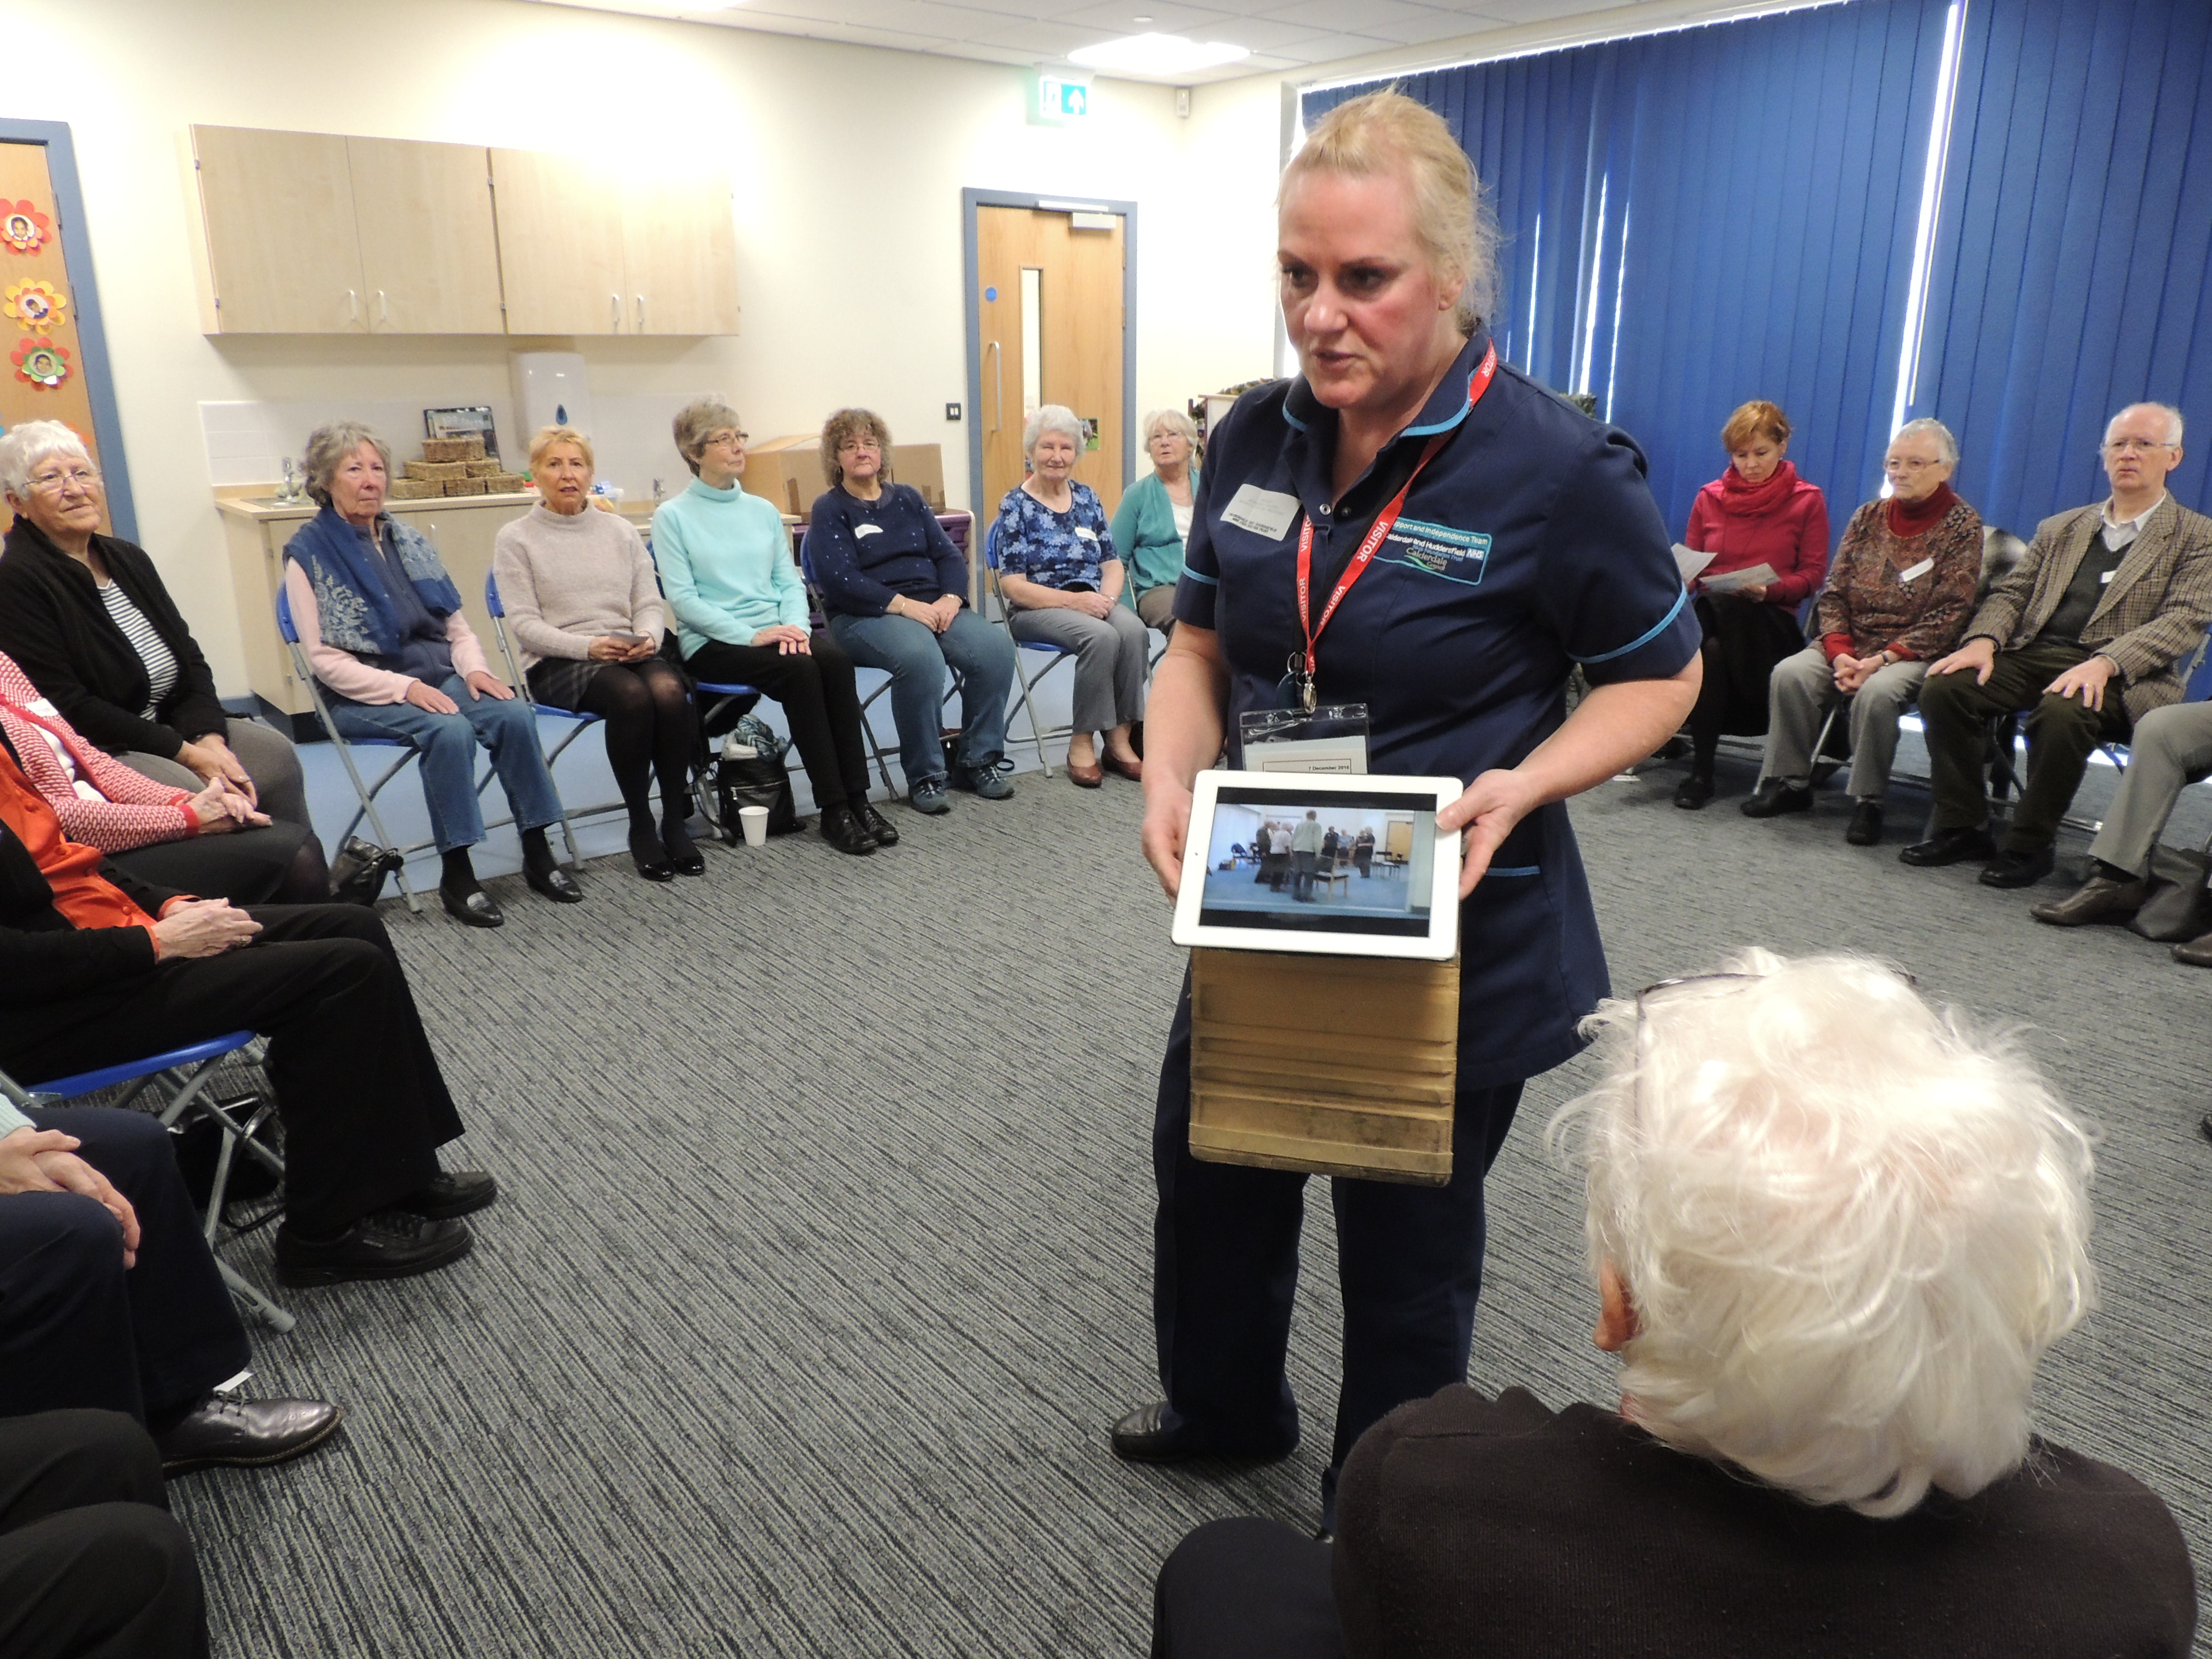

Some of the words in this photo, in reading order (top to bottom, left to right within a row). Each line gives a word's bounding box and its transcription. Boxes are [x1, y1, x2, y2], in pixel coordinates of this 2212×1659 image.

[1357, 521, 1388, 562] VISITOR
[1425, 527, 1470, 542] Independence
[1471, 536, 1488, 545] Team
[1406, 547, 1447, 565] Calderdale
[1413, 538, 1426, 547] and
[1426, 541, 1466, 557] Huddersfield
[1467, 549, 1484, 559] NHS
[1321, 586, 1346, 625] VISITOR
